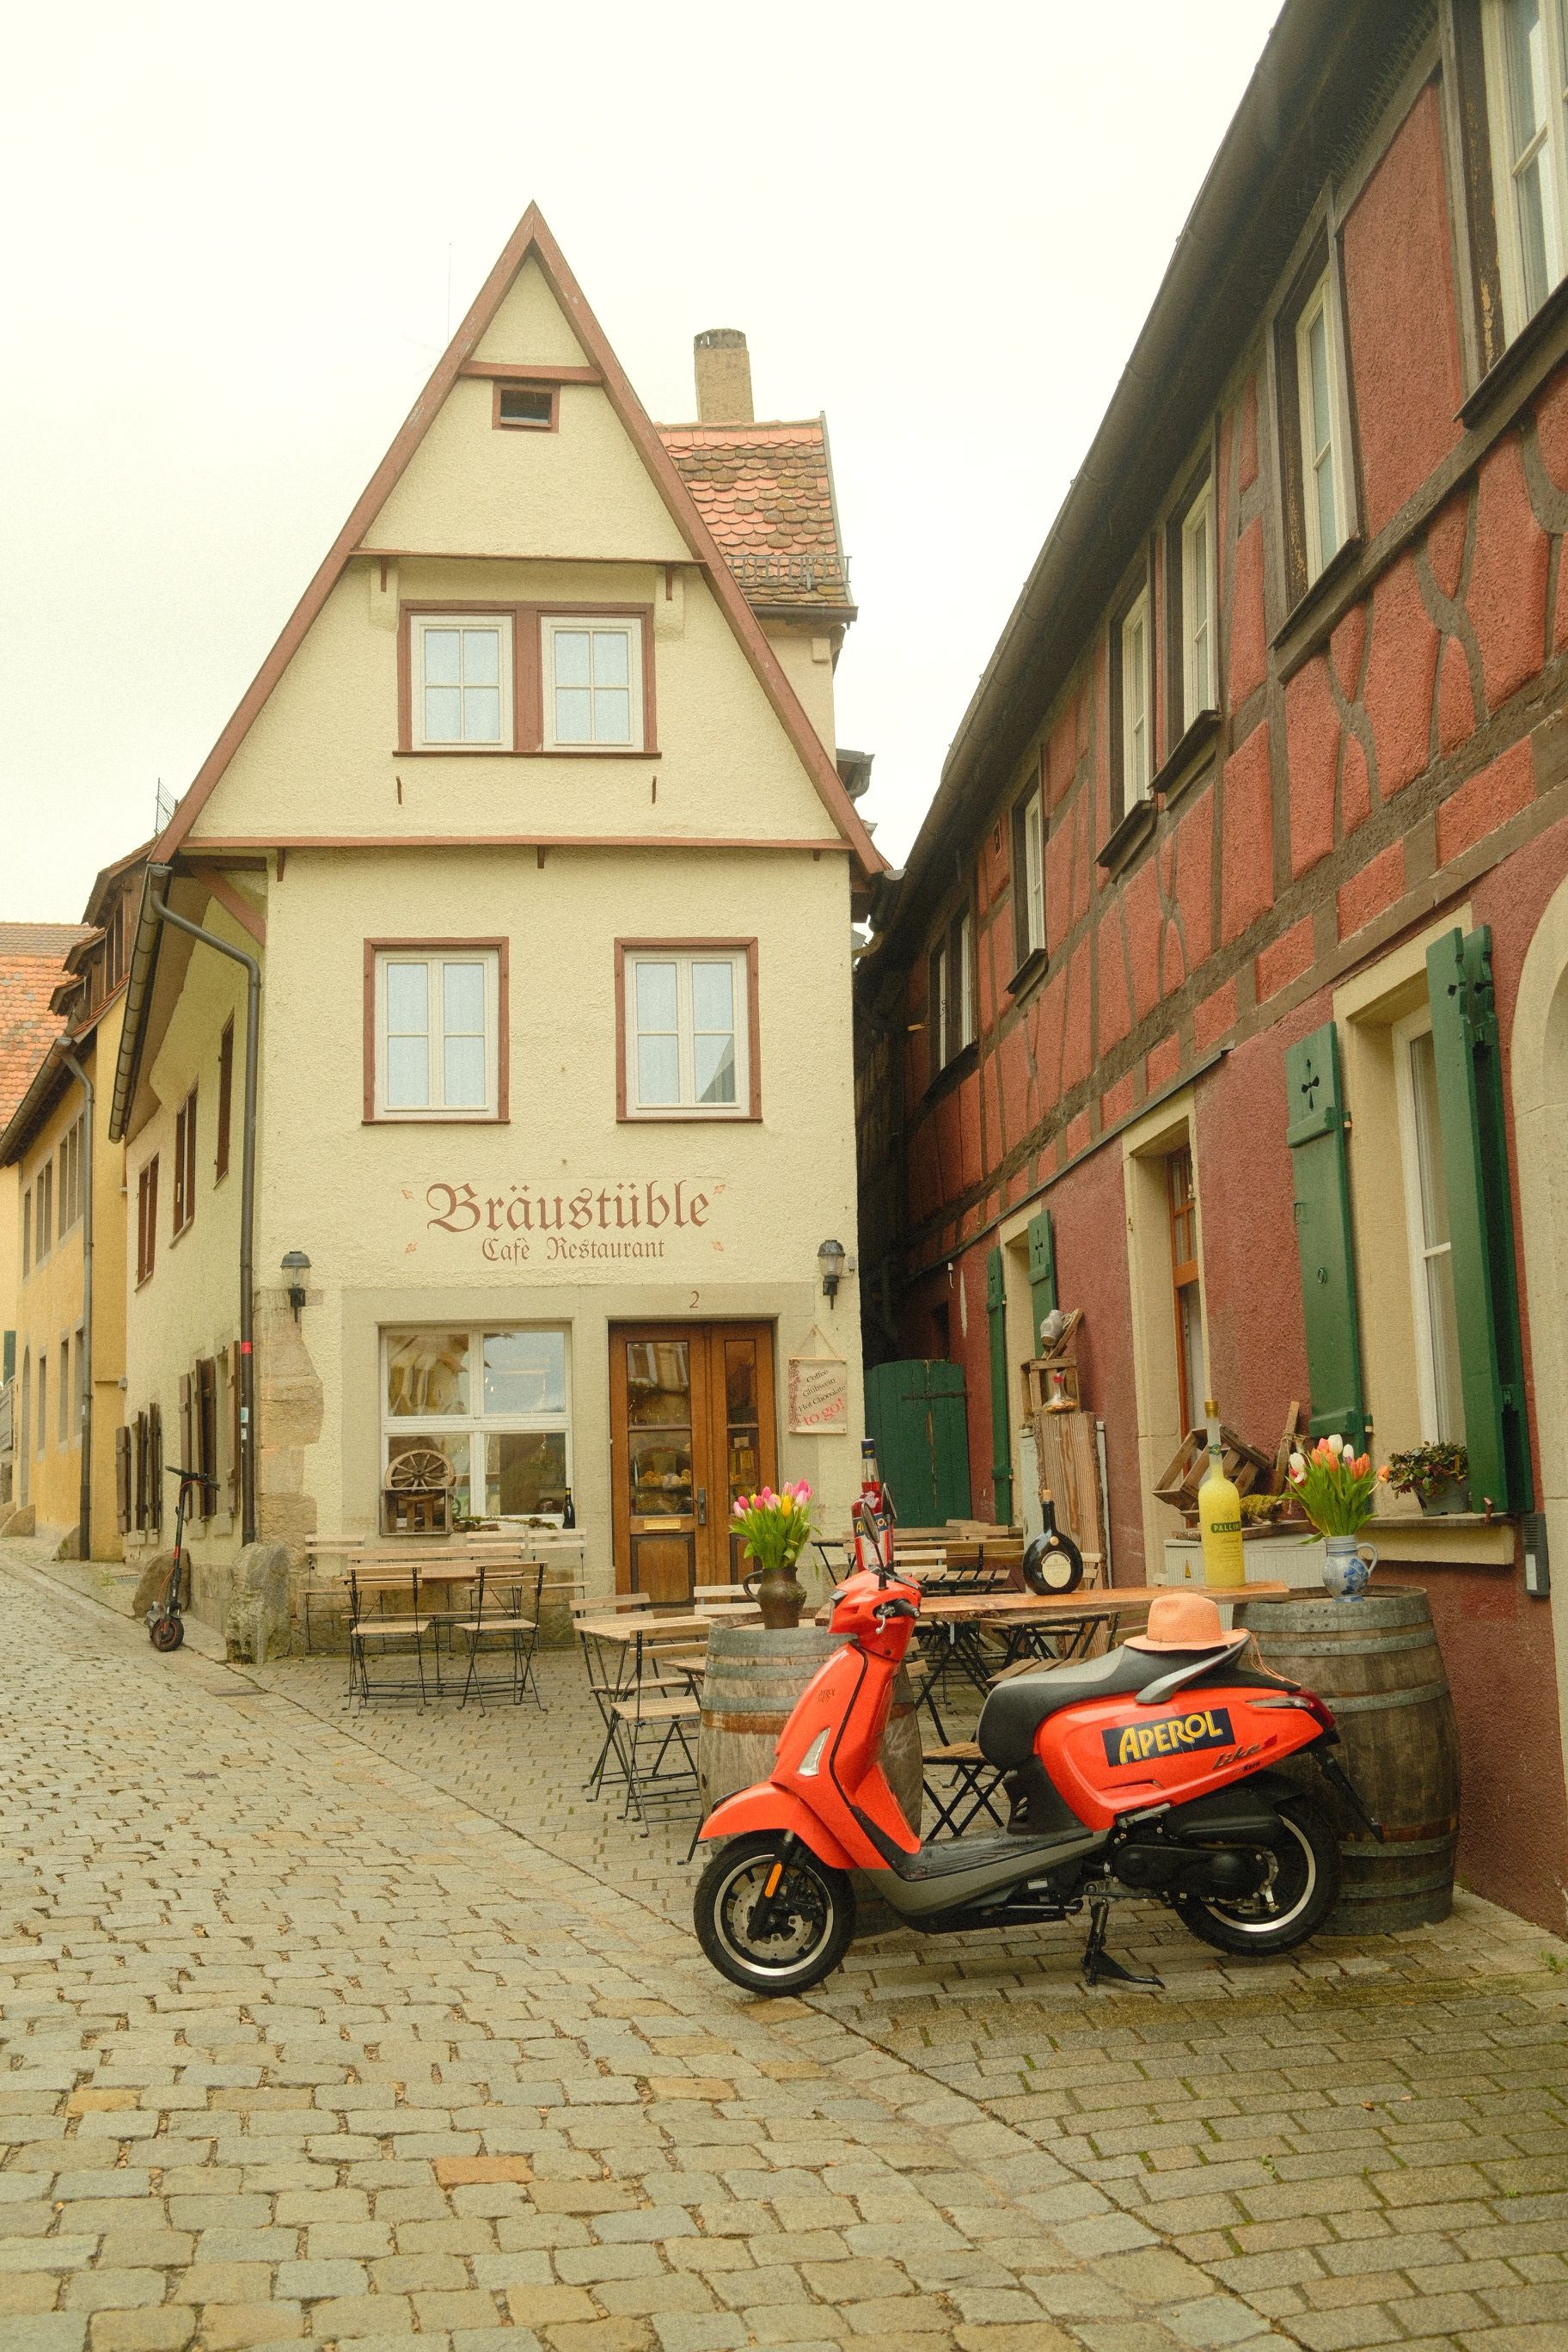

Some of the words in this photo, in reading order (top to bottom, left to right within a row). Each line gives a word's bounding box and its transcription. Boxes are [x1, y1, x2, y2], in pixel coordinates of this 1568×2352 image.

[426, 1179, 709, 1233] Bräustüble
[547, 1236, 665, 1260] Restaurant
[689, 1290, 700, 1308] 2
[806, 1369, 828, 1383] Coffee
[798, 1401, 813, 1412] Hot
[812, 1386, 846, 1405] Chocolate
[804, 1413, 819, 1425] to
[822, 1398, 845, 1421] go!
[1119, 1711, 1222, 1764] APEROL
